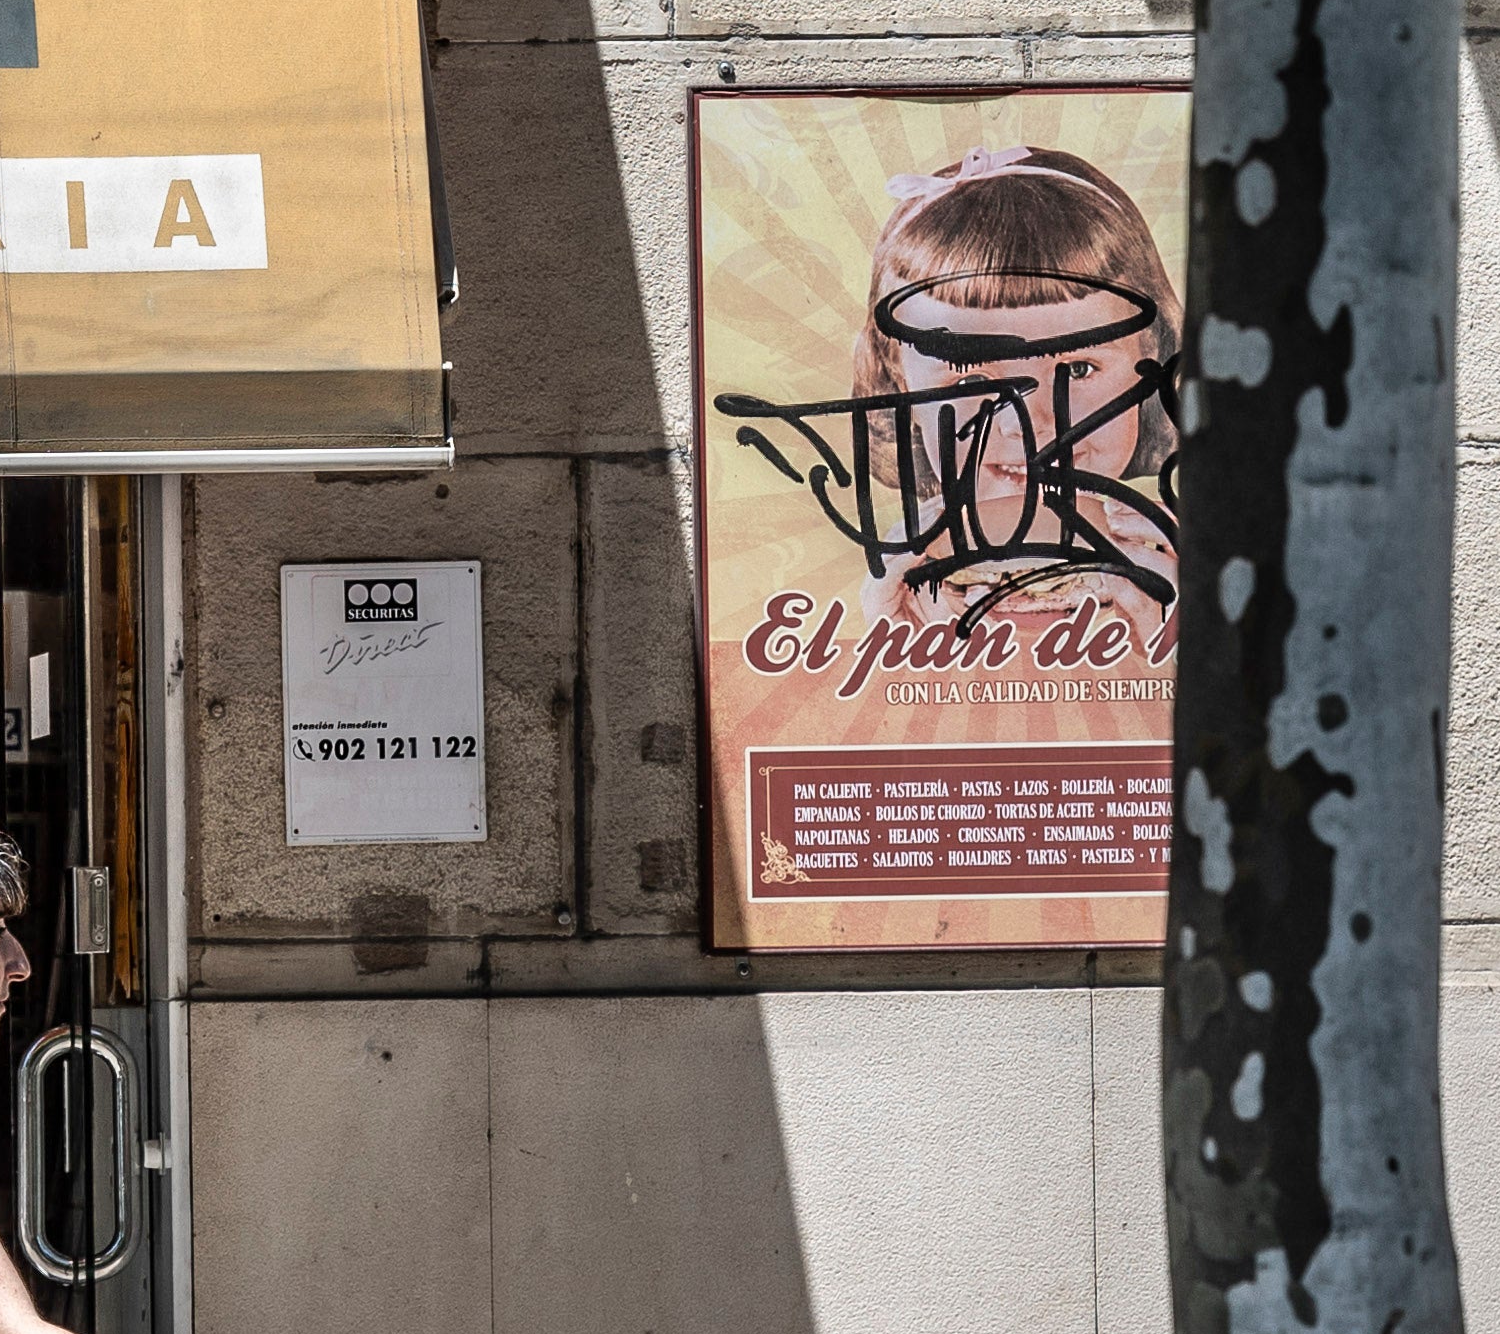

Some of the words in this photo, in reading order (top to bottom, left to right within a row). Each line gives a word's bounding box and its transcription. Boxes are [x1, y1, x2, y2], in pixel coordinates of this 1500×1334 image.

[347, 607, 414, 620] SECURITAS
[744, 593, 845, 674] El
[838, 618, 1020, 697] pan
[1036, 597, 1130, 667] de
[885, 682, 932, 705] CON
[934, 682, 962, 704] LA
[966, 680, 1059, 703] CALIDAD
[1064, 680, 1093, 702] DE
[1097, 679, 1176, 701] SIEMPR
[292, 721, 334, 731] atención
[337, 720, 388, 730] inmediata
[318, 738, 365, 761] 902
[376, 737, 417, 759] 121
[432, 736, 476, 758] 122
[794, 784, 816, 800] PAN
[819, 783, 872, 799] CALIENTE
[883, 779, 949, 798] PASTELERÍA
[961, 781, 1002, 797] PASTAS
[1014, 780, 1049, 796] LAZOS
[1061, 776, 1114, 795] BOLLERÍA
[1126, 778, 1175, 795] BOCADIL
[794, 853, 859, 868] BAGUETTES
[872, 852, 933, 867] SALADITOS
[948, 851, 1012, 866] HOJALDRES
[1026, 850, 1067, 865] TARTAS
[1081, 848, 1135, 864] PASTELES
[1149, 848, 1158, 863] Y
